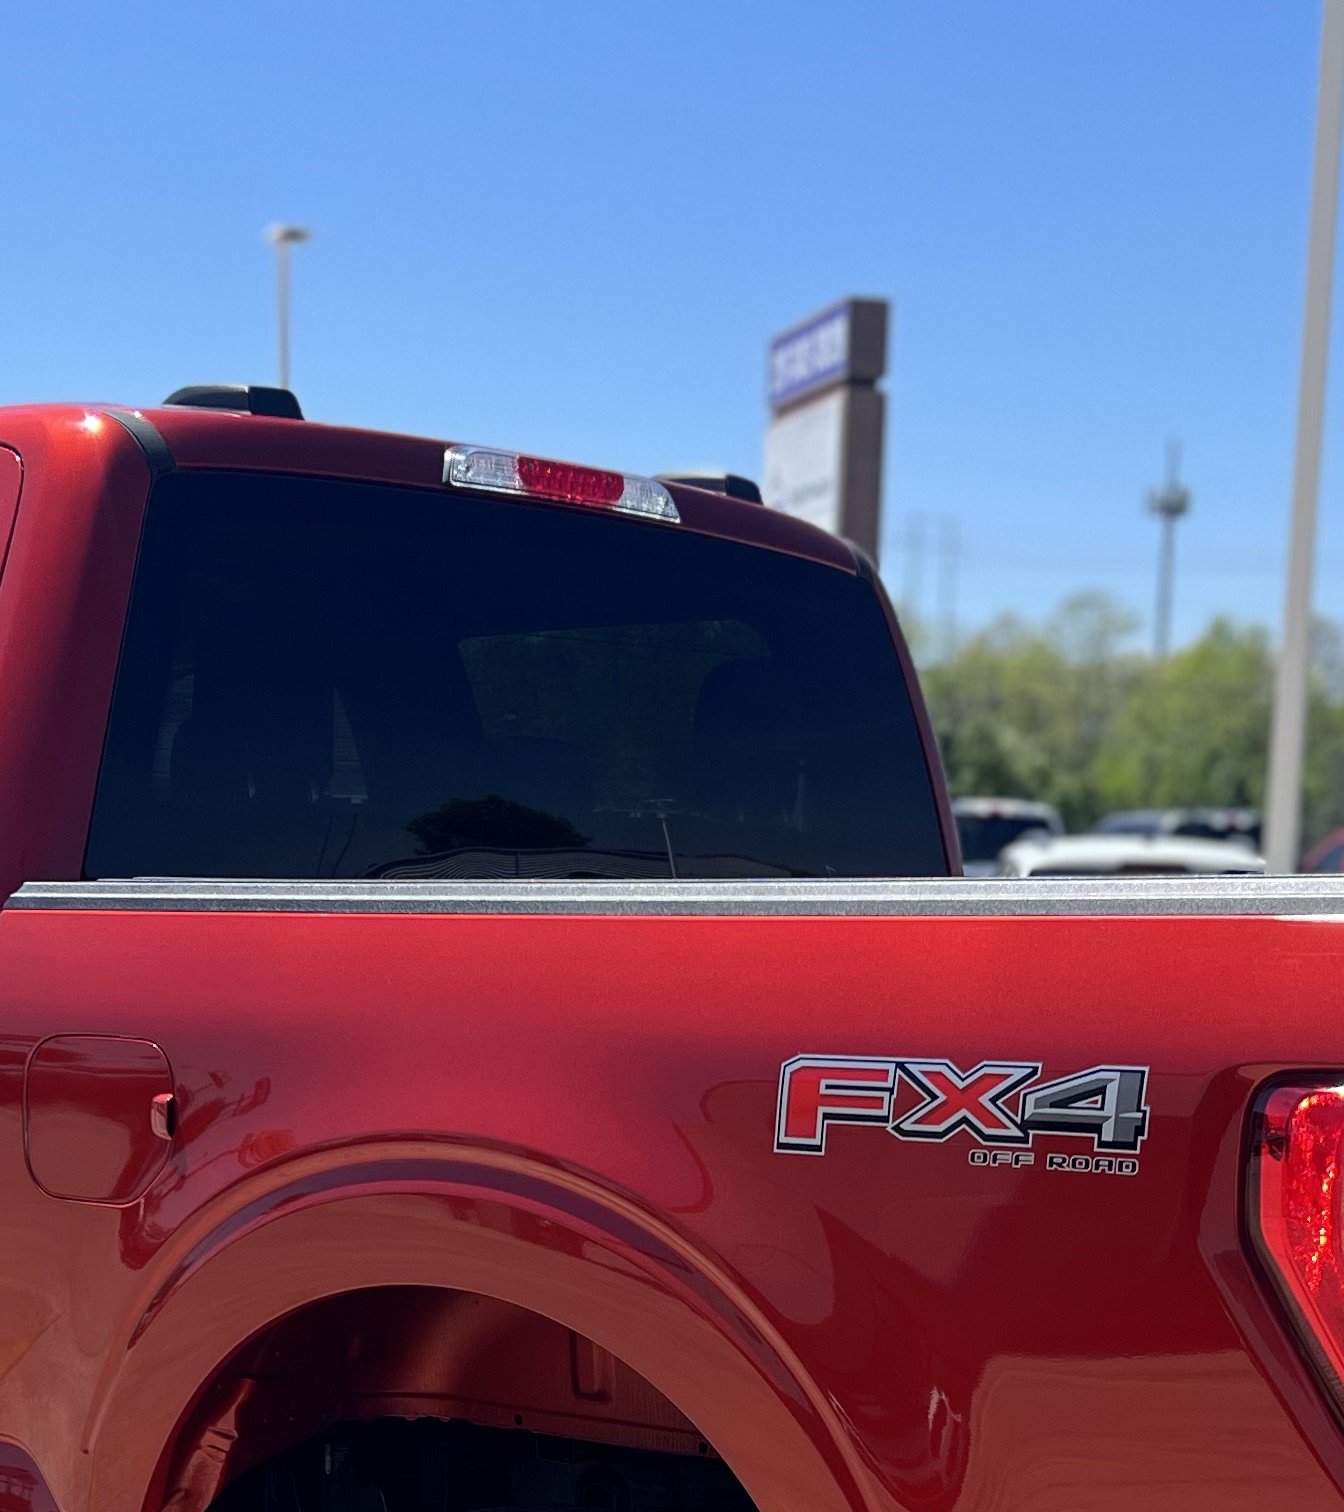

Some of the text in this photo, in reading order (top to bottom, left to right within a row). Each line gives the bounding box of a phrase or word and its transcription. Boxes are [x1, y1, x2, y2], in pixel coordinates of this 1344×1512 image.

[773, 1054, 1150, 1154] FX4
[968, 1149, 1139, 1175] OFF ROAD
